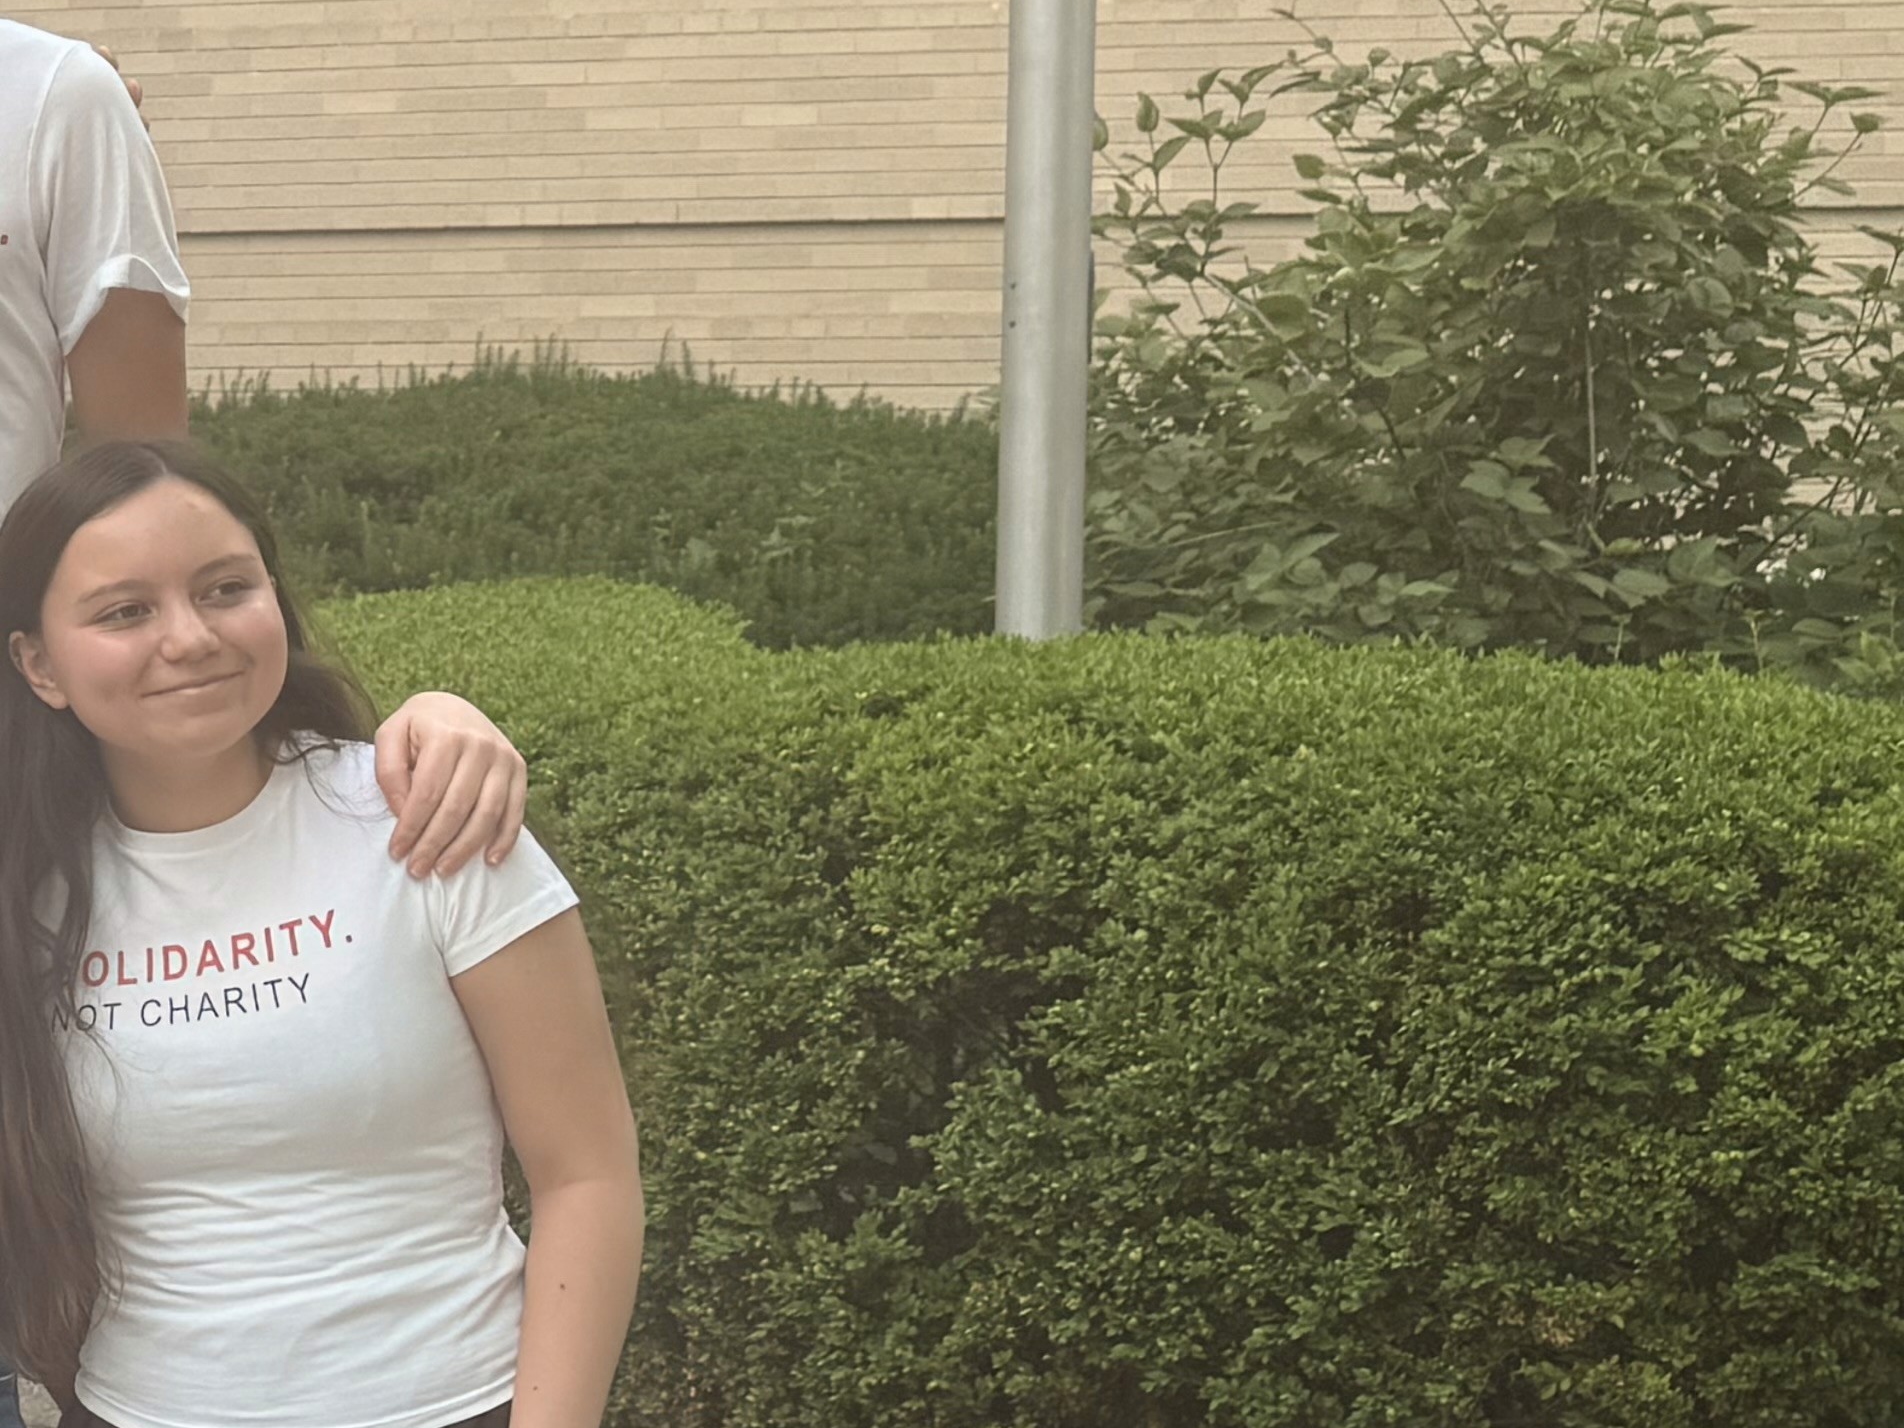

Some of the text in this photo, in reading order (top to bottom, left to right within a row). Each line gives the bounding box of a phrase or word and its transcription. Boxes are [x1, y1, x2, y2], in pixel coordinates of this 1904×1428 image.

[82, 909, 353, 988] OLIDARITY.
[51, 972, 310, 1033] NOT CHARITY
